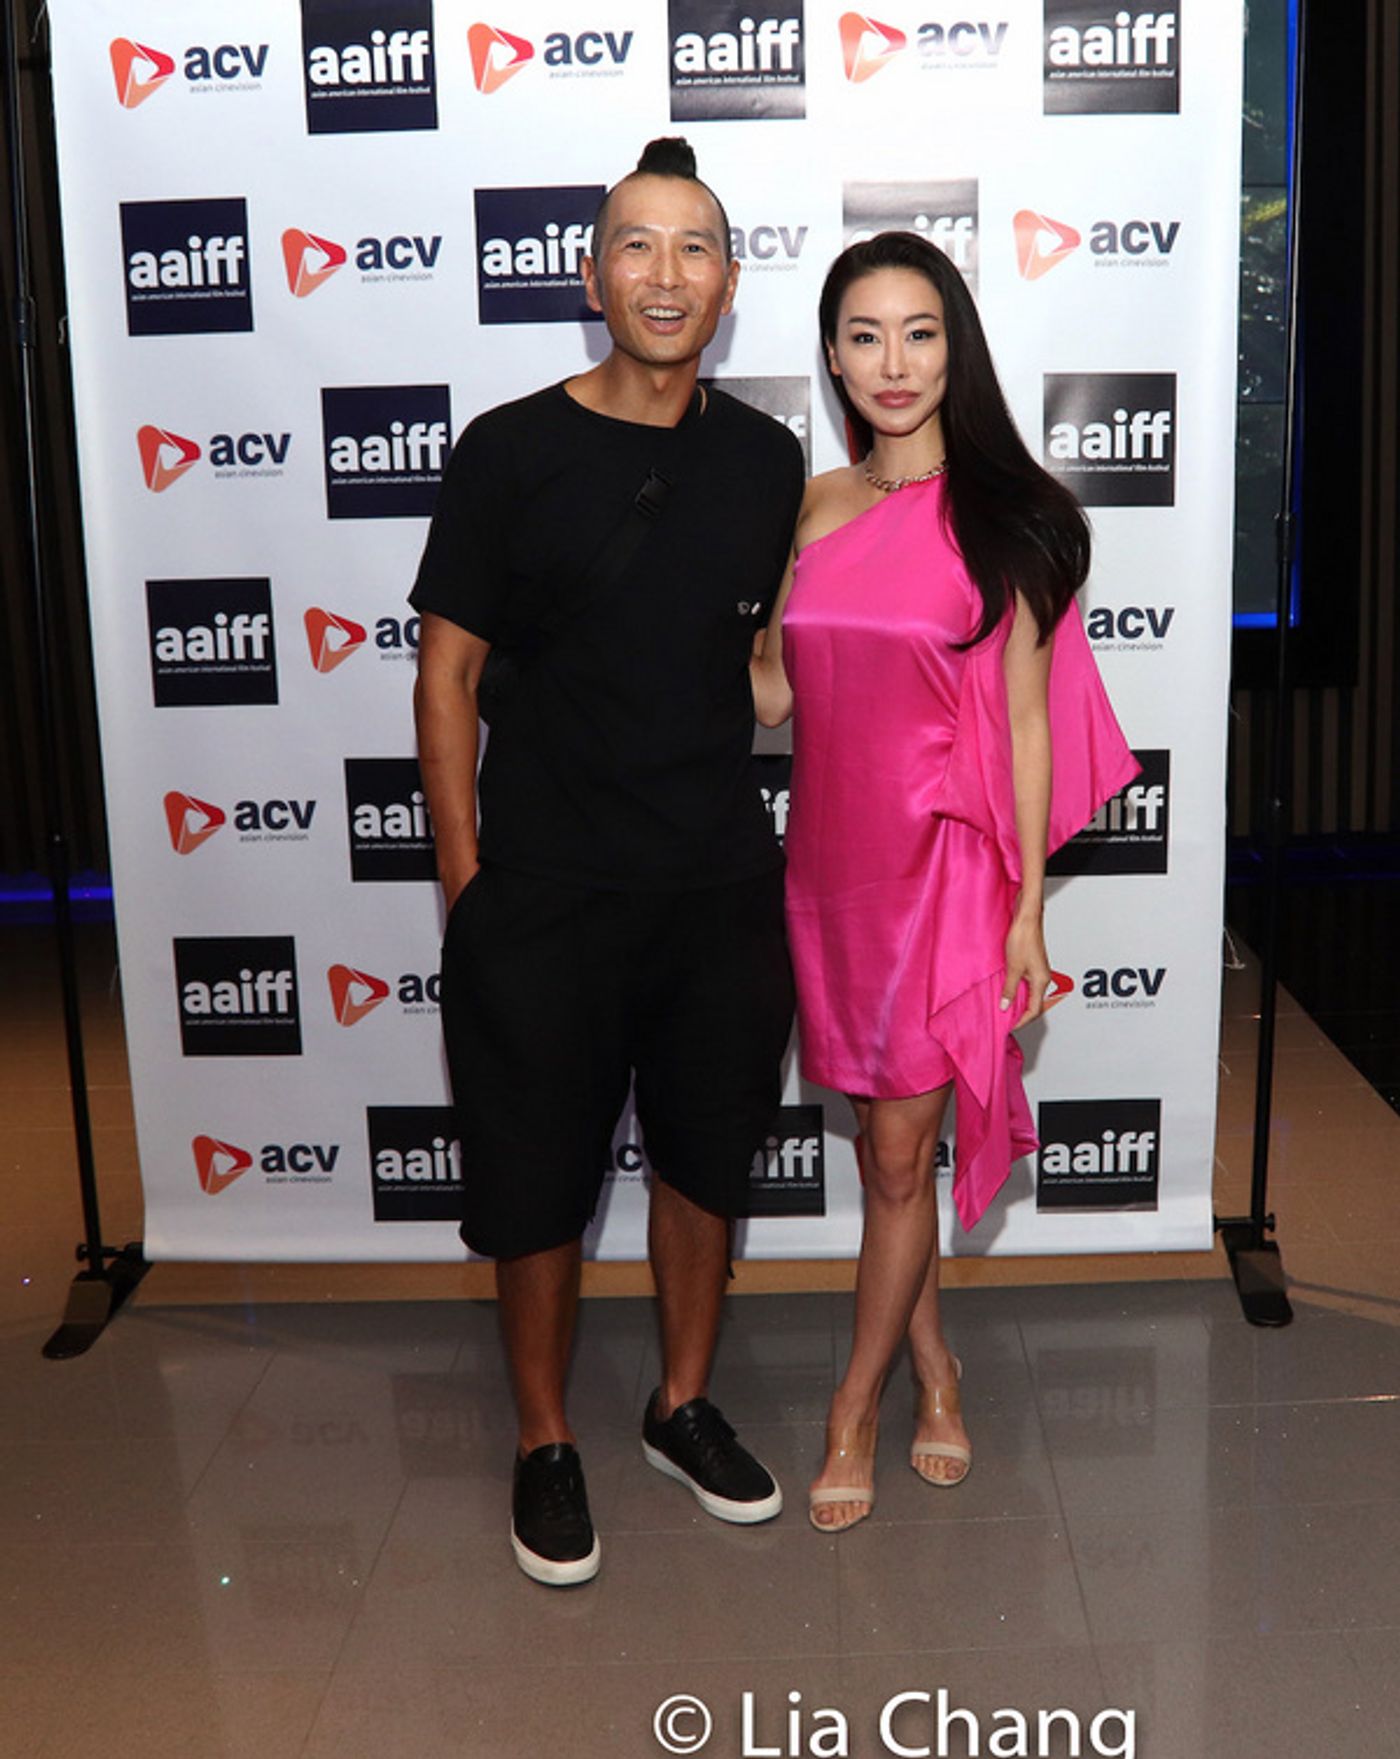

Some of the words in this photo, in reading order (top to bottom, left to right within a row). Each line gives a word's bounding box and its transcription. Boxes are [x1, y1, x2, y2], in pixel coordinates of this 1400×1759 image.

[309, 30, 429, 85] aaiff
[544, 30, 634, 66] acv
[674, 18, 799, 72] aaiff
[917, 22, 1009, 57] acv
[1050, 11, 1175, 66] aaiff
[184, 44, 269, 80] acv
[356, 236, 442, 270] acv
[730, 225, 808, 260] acv
[1090, 221, 1180, 254] acv
[128, 236, 243, 288] aaiff
[209, 432, 291, 467] acv
[329, 421, 447, 473] aaiff
[1050, 408, 1170, 459] aaiff
[155, 612, 269, 662] aaiff
[375, 616, 420, 649] ac
[1087, 606, 1174, 640] acv
[234, 800, 316, 831] acv
[354, 791, 428, 838] aai
[1083, 785, 1164, 831] iff
[183, 968, 292, 1015] aaiff
[398, 973, 441, 1003] ac
[1082, 968, 1167, 998] acv
[260, 1144, 340, 1173] acv
[375, 1136, 462, 1181] aaif
[749, 1136, 819, 1178] iff
[1042, 1130, 1154, 1174] aaiff
